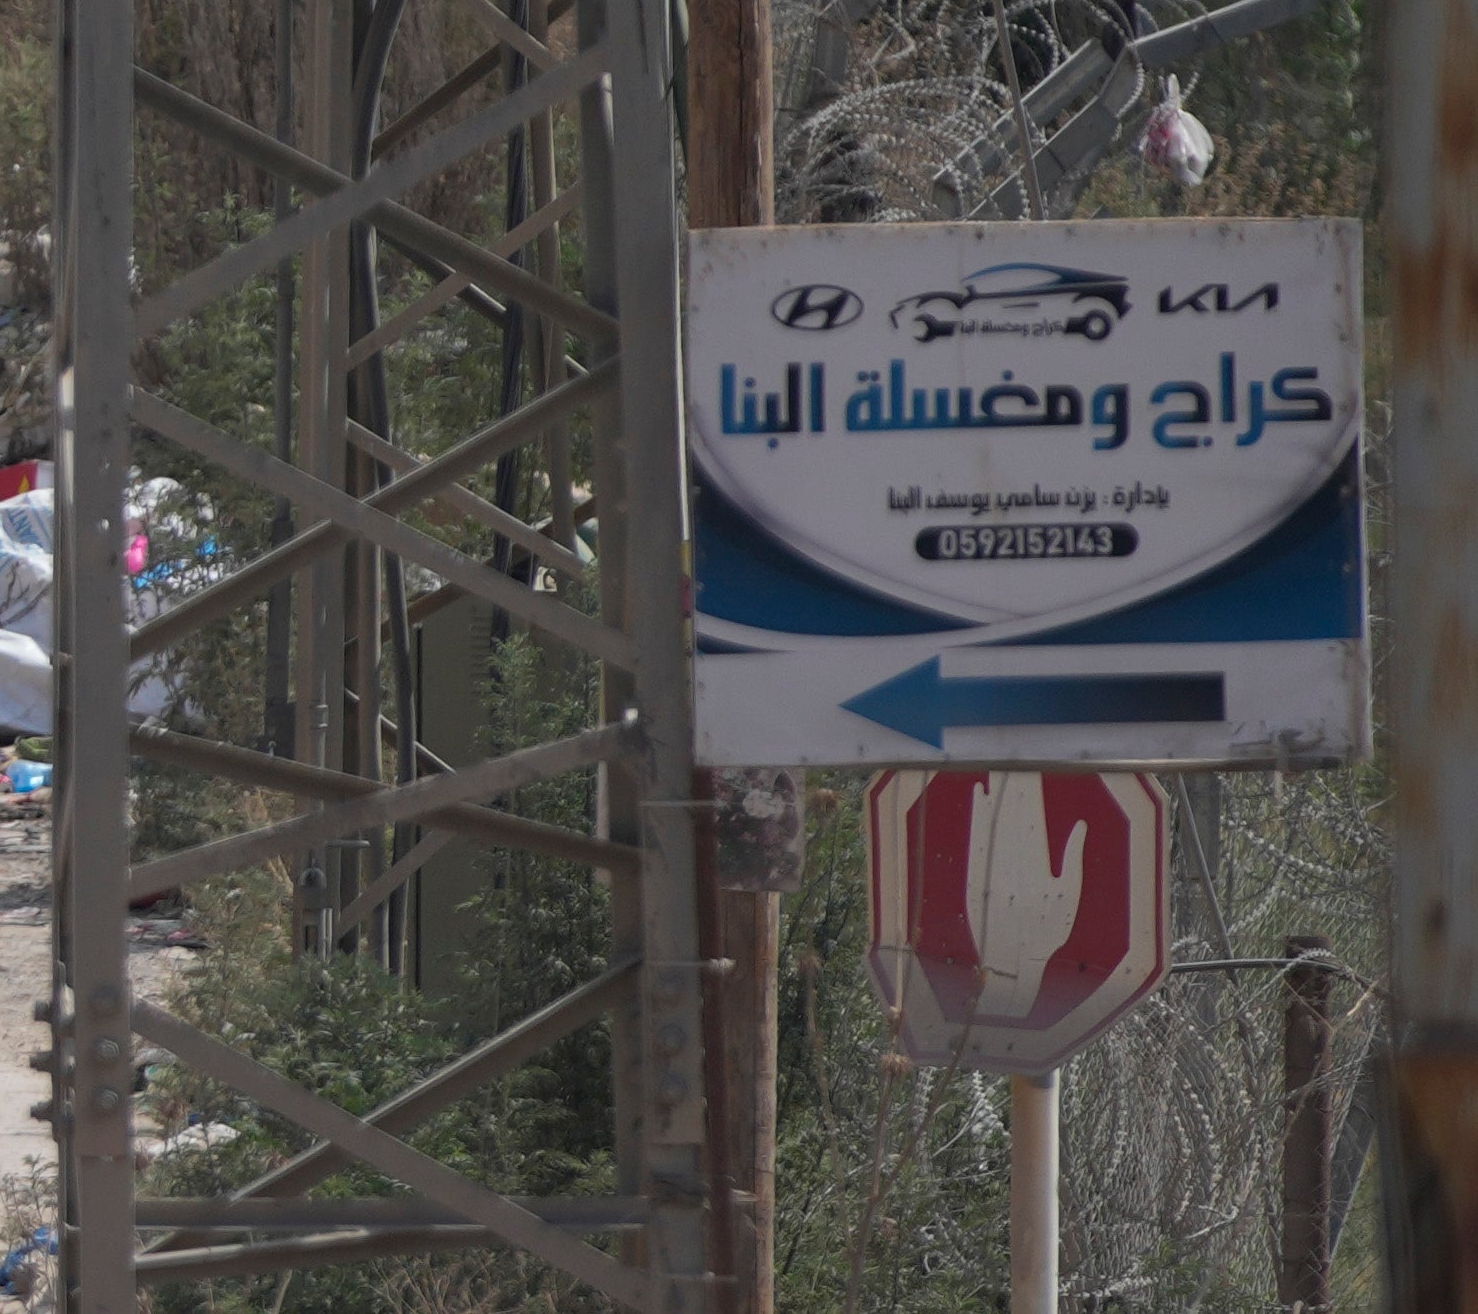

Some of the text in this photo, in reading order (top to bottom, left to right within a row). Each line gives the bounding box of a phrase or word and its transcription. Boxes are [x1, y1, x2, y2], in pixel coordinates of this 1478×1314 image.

[720, 351, 1333, 451] كراج ومغسلة البنا
[887, 485, 922, 514] البنا
[925, 488, 991, 516] يوسف
[995, 483, 1060, 511] سامي
[938, 525, 1114, 558] 0592152143
